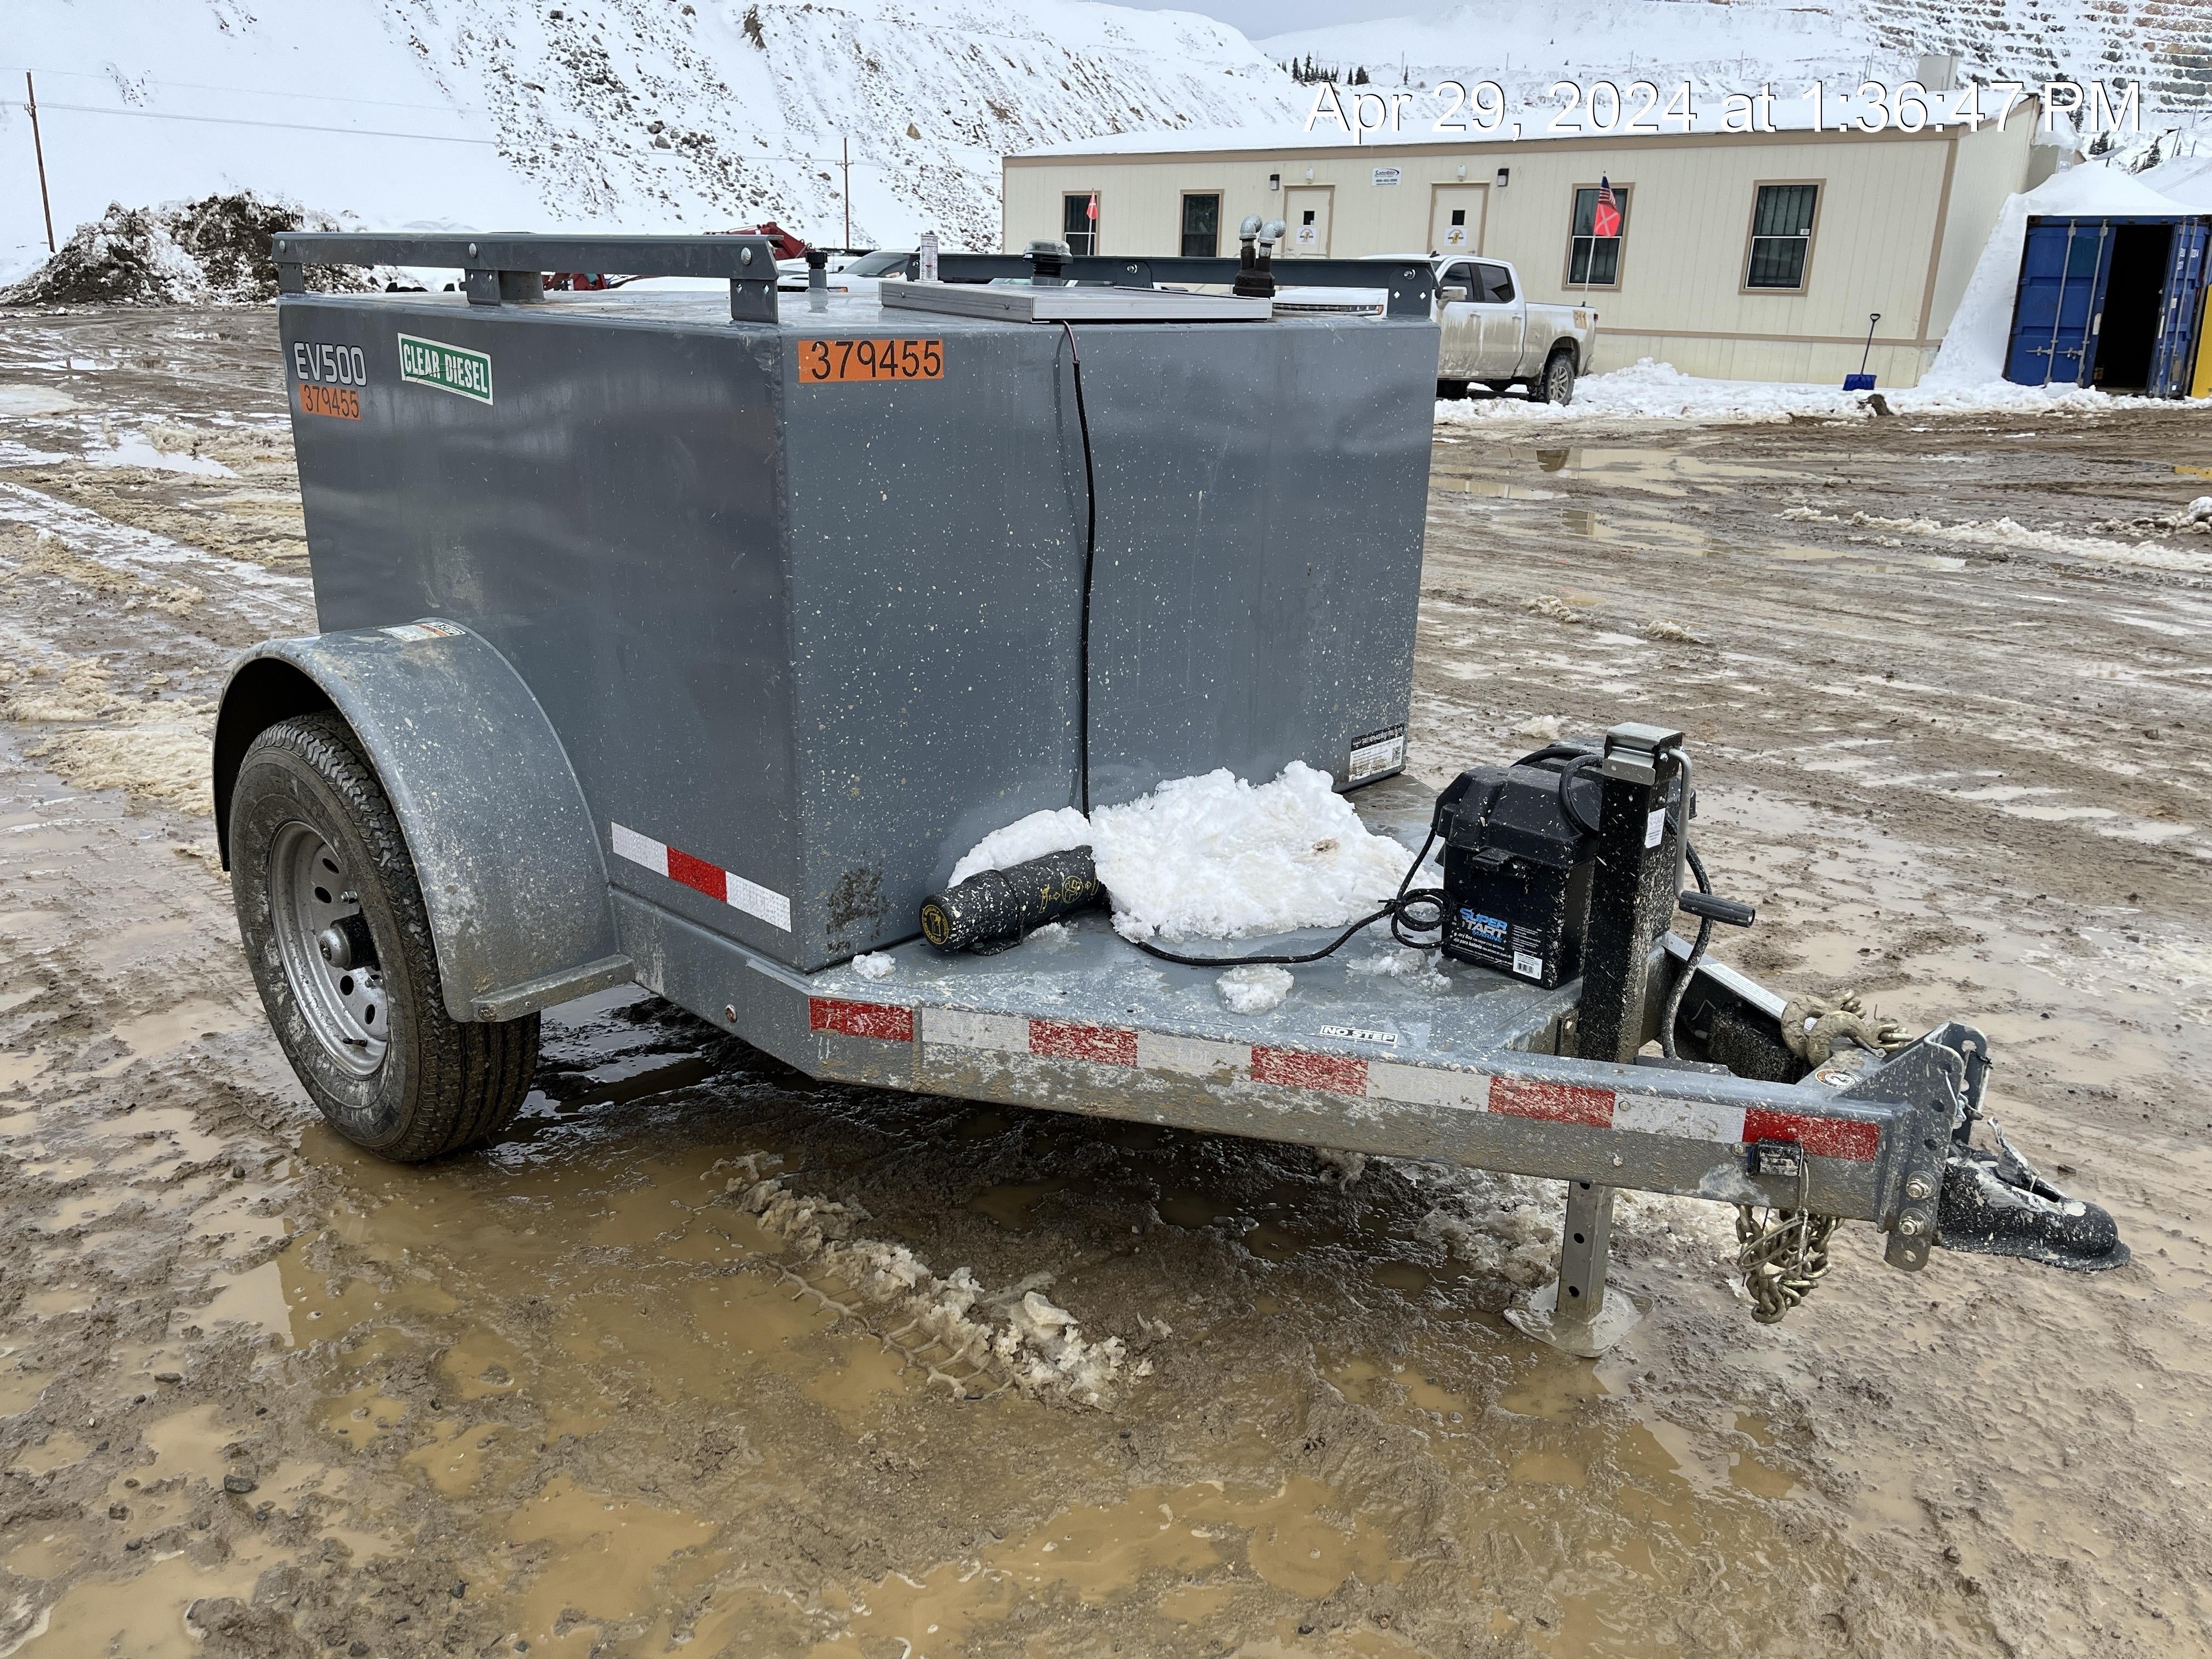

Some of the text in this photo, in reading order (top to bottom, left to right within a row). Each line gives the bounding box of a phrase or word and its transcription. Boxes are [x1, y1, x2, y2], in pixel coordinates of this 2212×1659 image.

[294, 342, 366, 386] EV500
[403, 343, 488, 394] CLEAR DIESEL
[811, 340, 941, 380] 379455
[303, 384, 360, 419] 379455
[1453, 917, 1508, 938] TART
[1459, 907, 1508, 931] SUPER
[1471, 929, 1503, 943] MARINE
[1323, 1026, 1395, 1041] NO STEP
